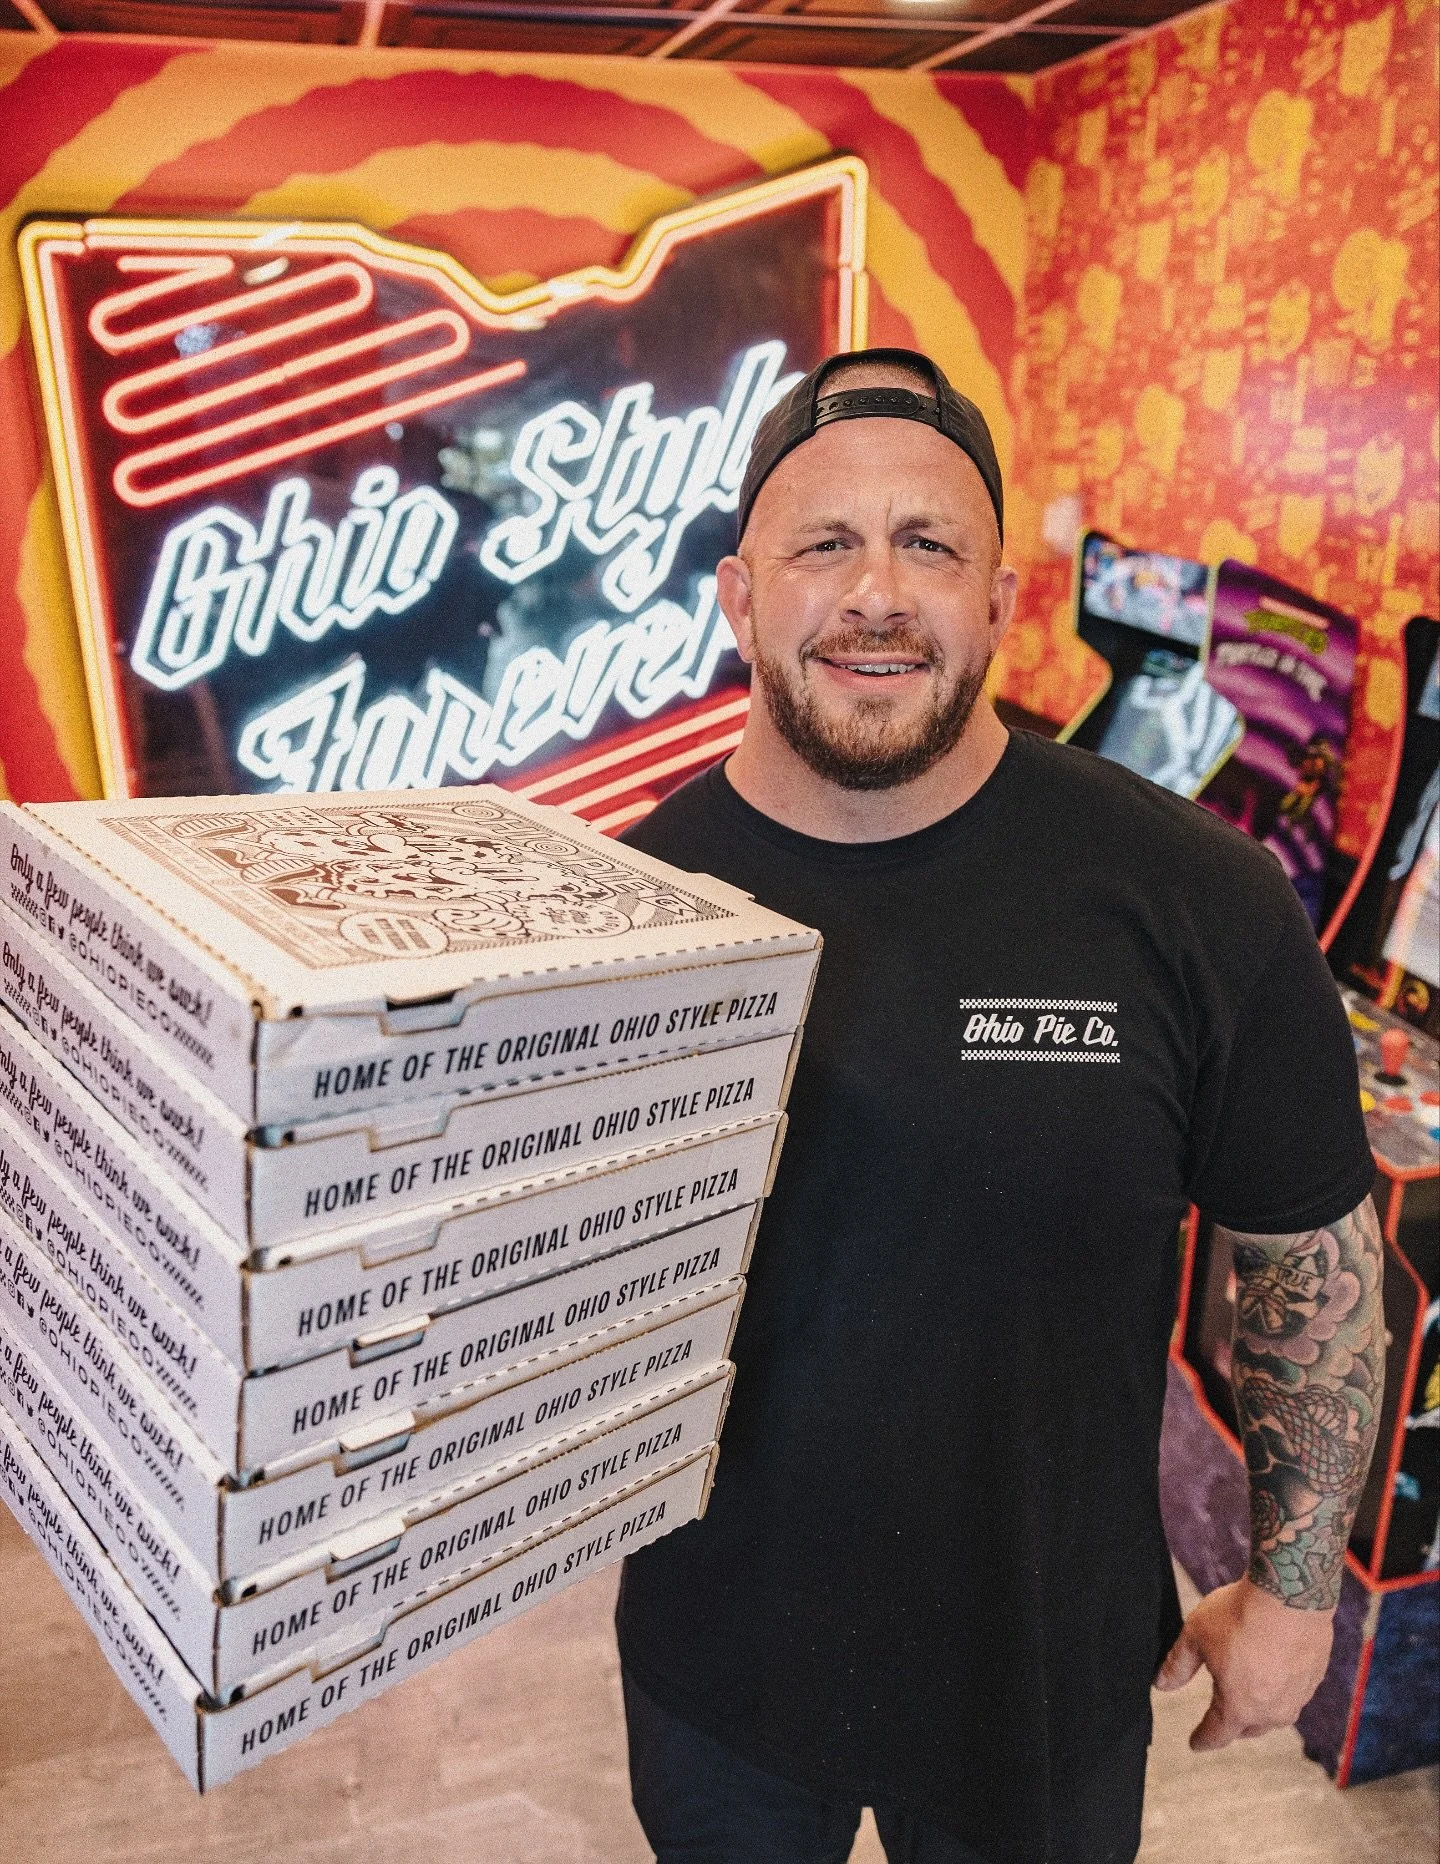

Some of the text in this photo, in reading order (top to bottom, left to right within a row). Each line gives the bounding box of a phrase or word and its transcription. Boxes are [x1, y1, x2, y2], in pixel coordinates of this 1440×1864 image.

[131, 340, 806, 690] Ohio Styl
[564, 857, 664, 899] PIE
[313, 991, 777, 1099] HOME OF THE ORIGINAL OHIO STYLE PIZZA
[963, 1013, 1119, 1047] Ohio Pie Co.
[0, 1049, 17, 1089] nly
[28, 1075, 52, 1115] few
[53, 1108, 91, 1158] people
[94, 1143, 128, 1198] think
[304, 1077, 754, 1218] HOME OF THE ORIGINAL OHIO STYLE PIZZA
[21, 1174, 46, 1215] few
[46, 1209, 86, 1261] people
[89, 1247, 124, 1303] think
[297, 1168, 738, 1337] HOME OF THE ORIGINAL OHIO STYLE PIZZA
[12, 1252, 40, 1293] few
[39, 1284, 80, 1343] people
[82, 1329, 115, 1389] think
[292, 1247, 720, 1434] HOME OF THE ORIGINAL OHIO STYLE PIZZA
[13, 1352, 38, 1393] few
[38, 1386, 76, 1447] people
[79, 1433, 111, 1496] think
[258, 1339, 692, 1544] HOME OF THE ORIGINAL OHIO STYLE PIZZA
[3, 1443, 26, 1484] few
[27, 1483, 63, 1541] people
[66, 1533, 97, 1593] think
[252, 1422, 682, 1655] HOME OF THE ORIGINAL OHIO STYLE PIZZA
[240, 1500, 665, 1755] HOME OF THE ORIGINAL OHIO STYLE PIZZA
